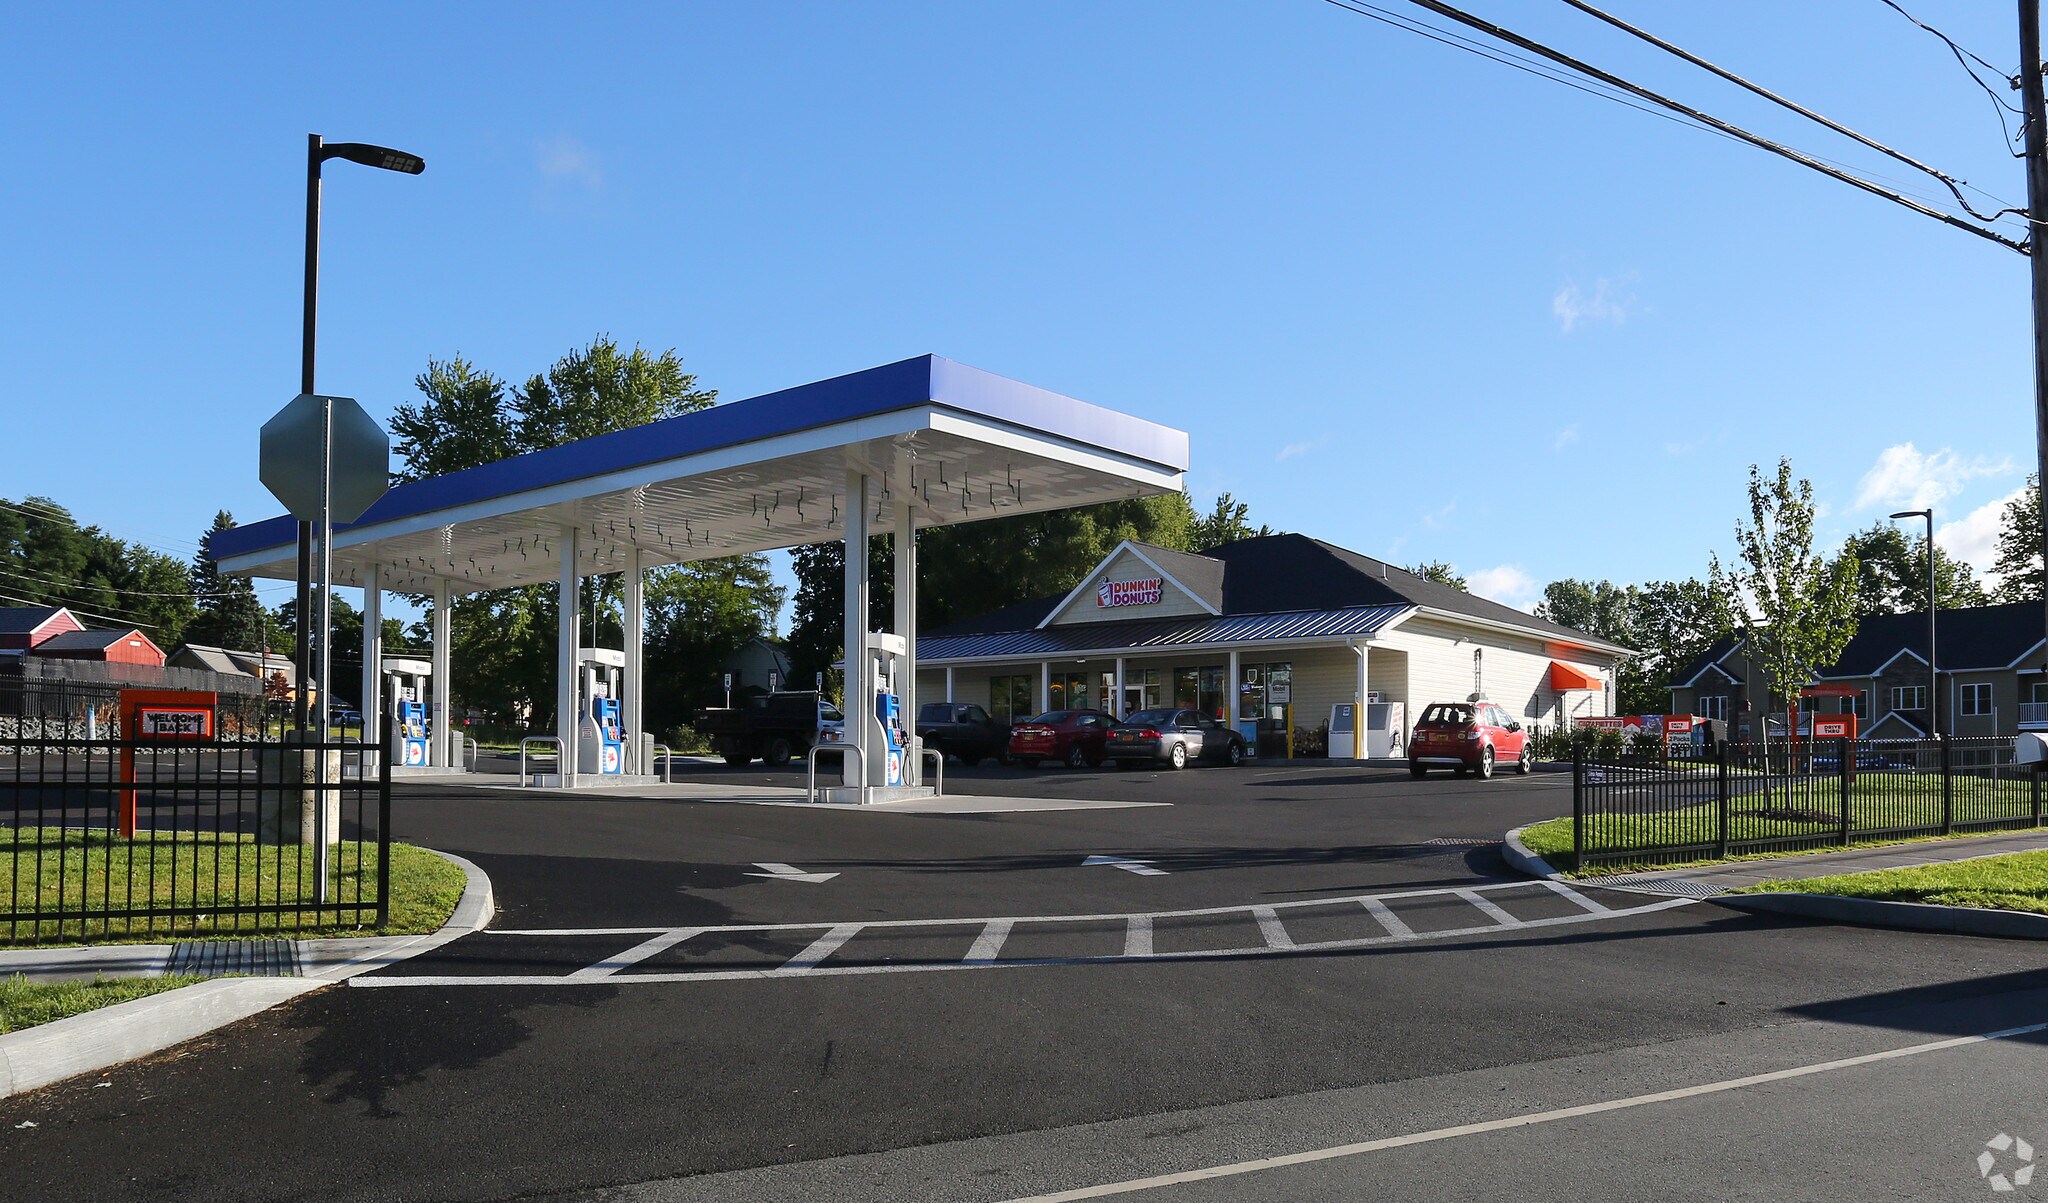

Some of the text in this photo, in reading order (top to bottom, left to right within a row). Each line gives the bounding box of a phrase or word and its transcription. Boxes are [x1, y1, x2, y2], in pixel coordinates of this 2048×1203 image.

[1113, 579, 1161, 594] DUNKIN'
[1113, 591, 1159, 605] DONUTS
[147, 713, 204, 723] WELCOME
[159, 723, 192, 732] BACK
